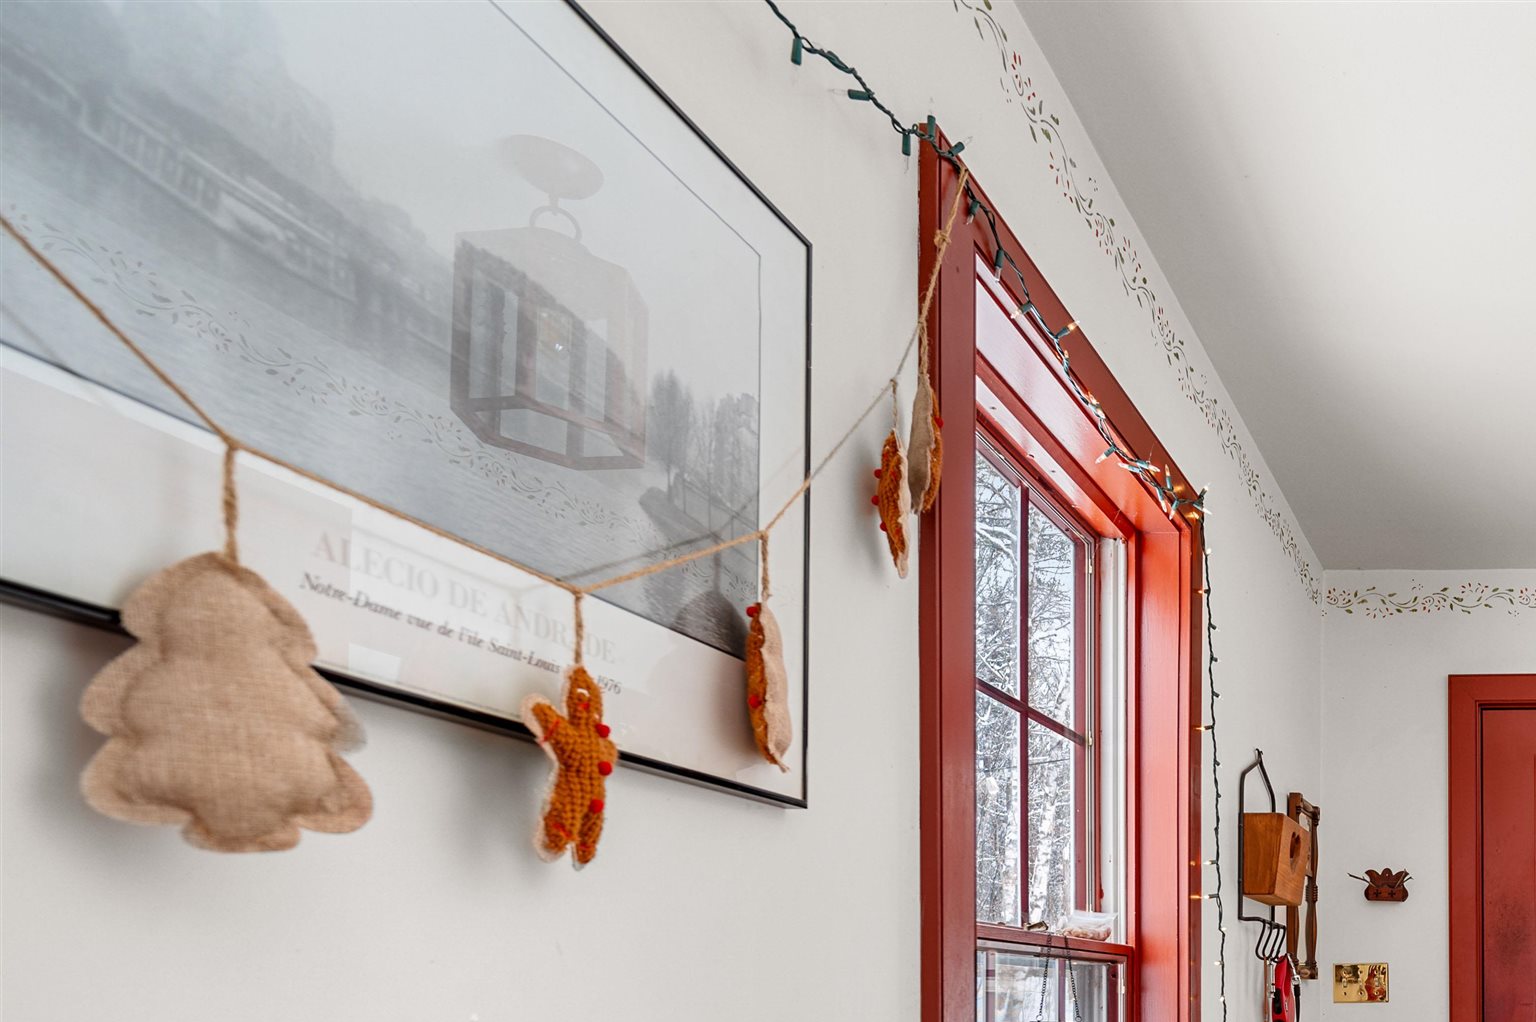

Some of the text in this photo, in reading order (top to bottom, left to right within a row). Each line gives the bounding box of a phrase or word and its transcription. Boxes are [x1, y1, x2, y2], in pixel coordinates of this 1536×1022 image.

[299, 571, 402, 620] Notre-Dame
[407, 614, 433, 630] vue
[437, 620, 454, 638] de
[488, 639, 560, 673] Saint-Louis
[449, 581, 487, 617] DE
[495, 601, 615, 664] ANDRDE
